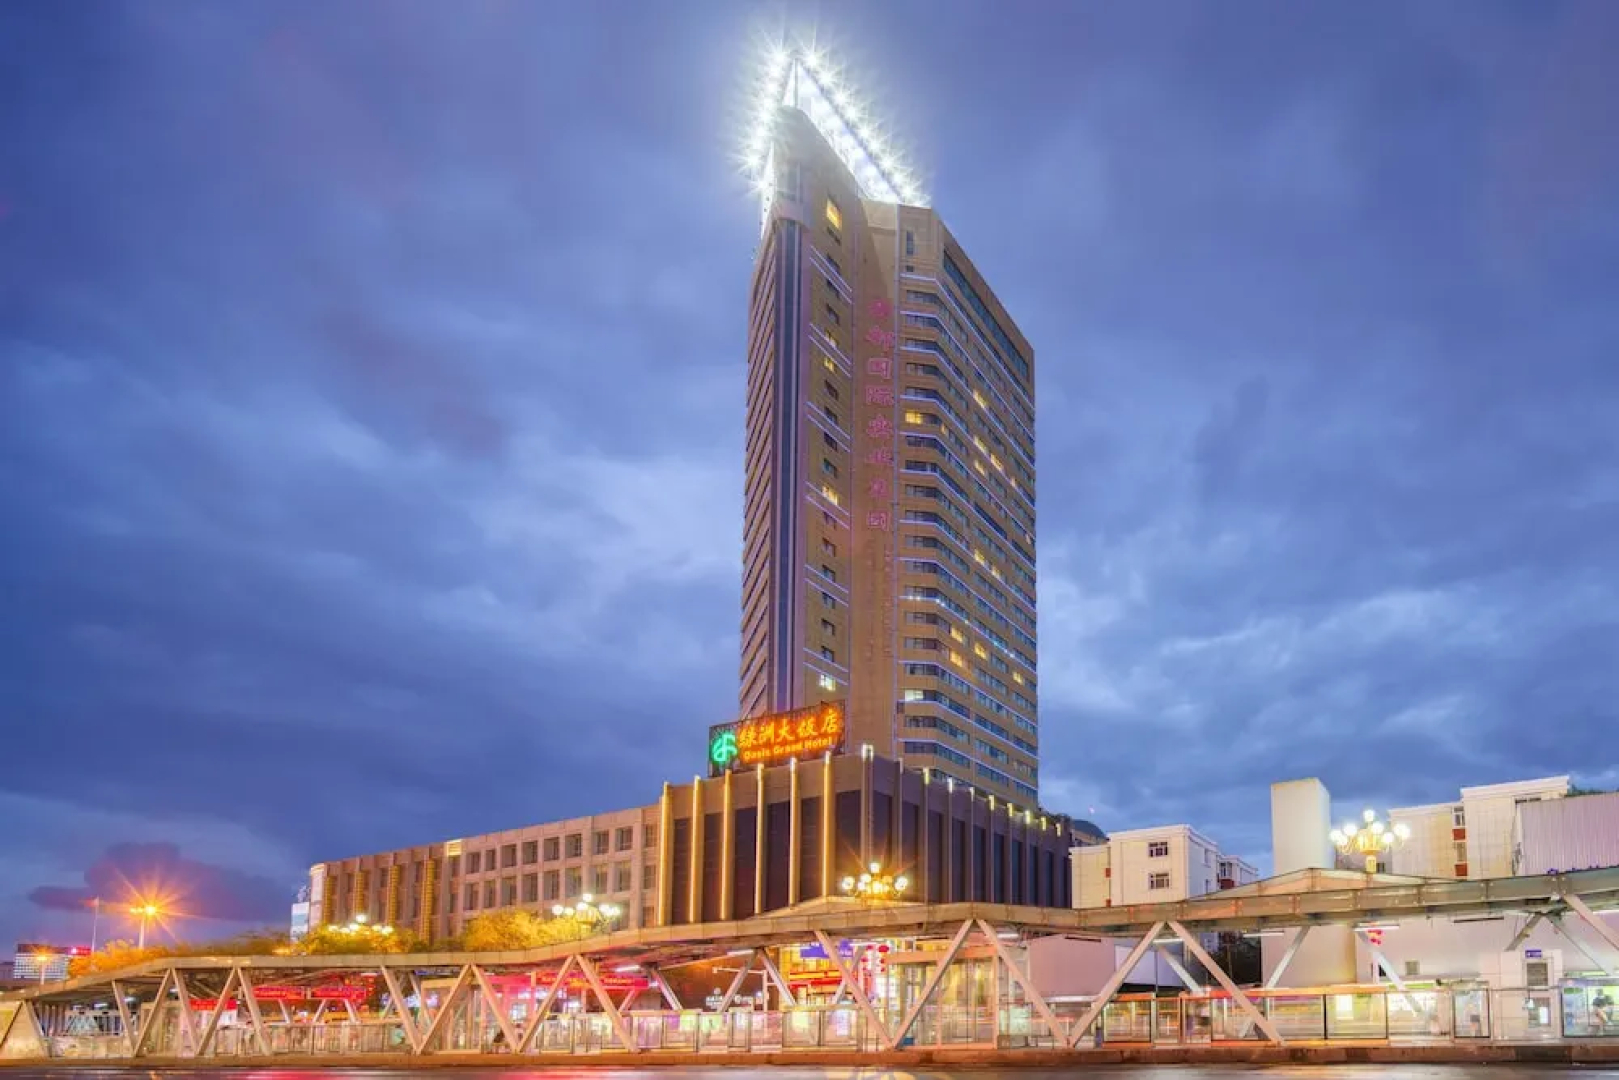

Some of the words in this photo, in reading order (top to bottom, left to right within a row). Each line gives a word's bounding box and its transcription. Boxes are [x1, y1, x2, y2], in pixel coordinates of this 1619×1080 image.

[744, 747, 772, 760] Oasis
[773, 742, 803, 755] Grand
[804, 737, 832, 750] Hotel
